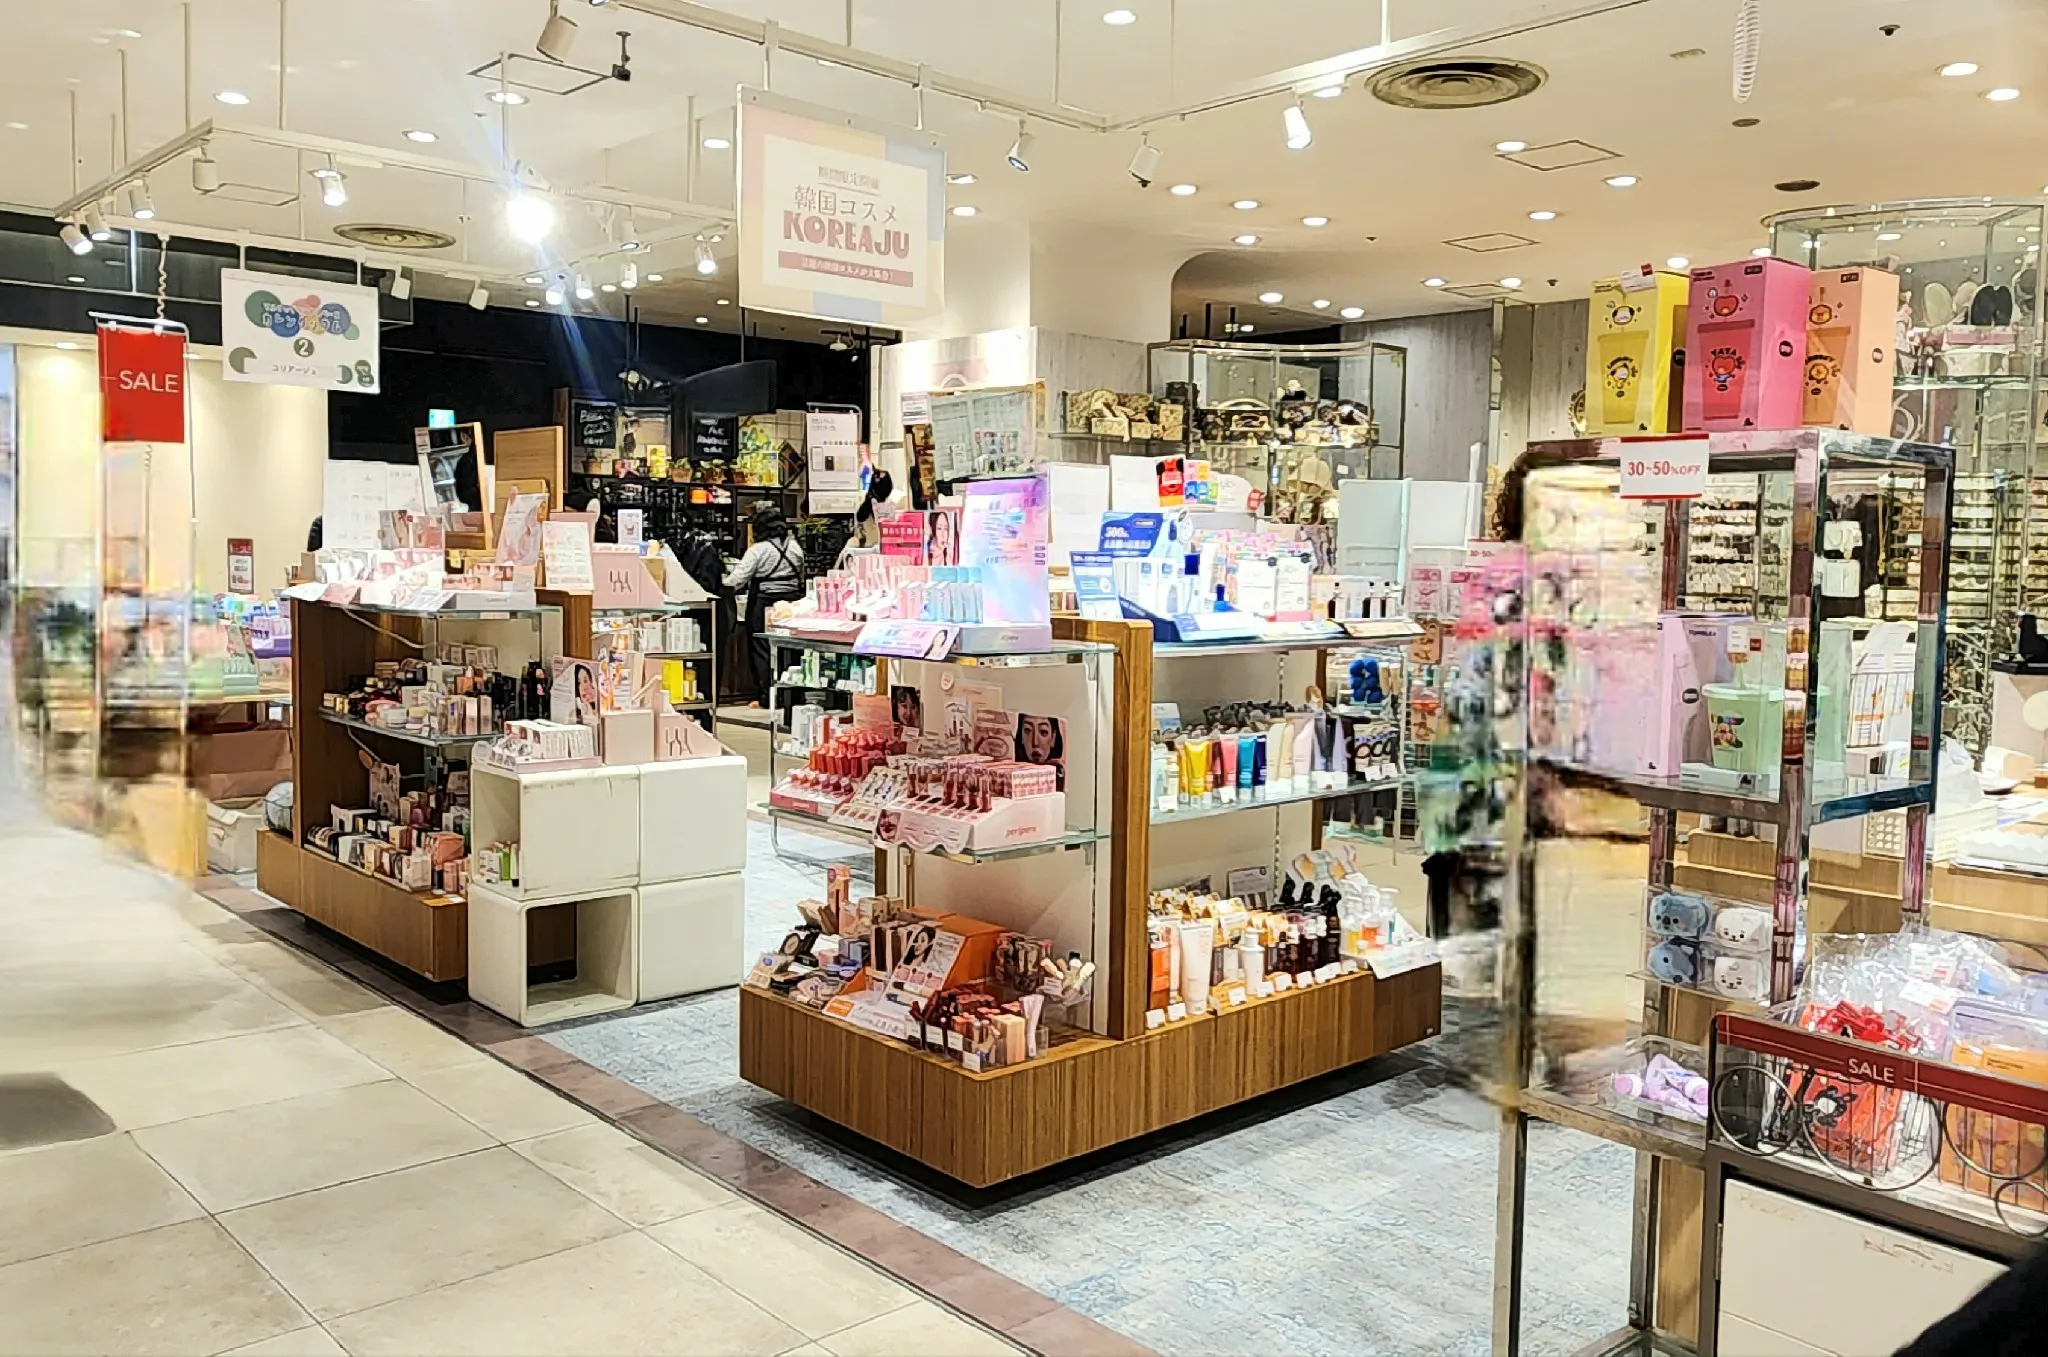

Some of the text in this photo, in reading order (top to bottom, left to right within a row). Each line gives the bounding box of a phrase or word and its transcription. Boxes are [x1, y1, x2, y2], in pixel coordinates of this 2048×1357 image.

[794, 184, 897, 224] 韓国コスメ
[783, 210, 910, 259] KOREAJU
[298, 339, 309, 356] 2
[119, 369, 179, 393] SALE
[1848, 1058, 1895, 1084] SALE
